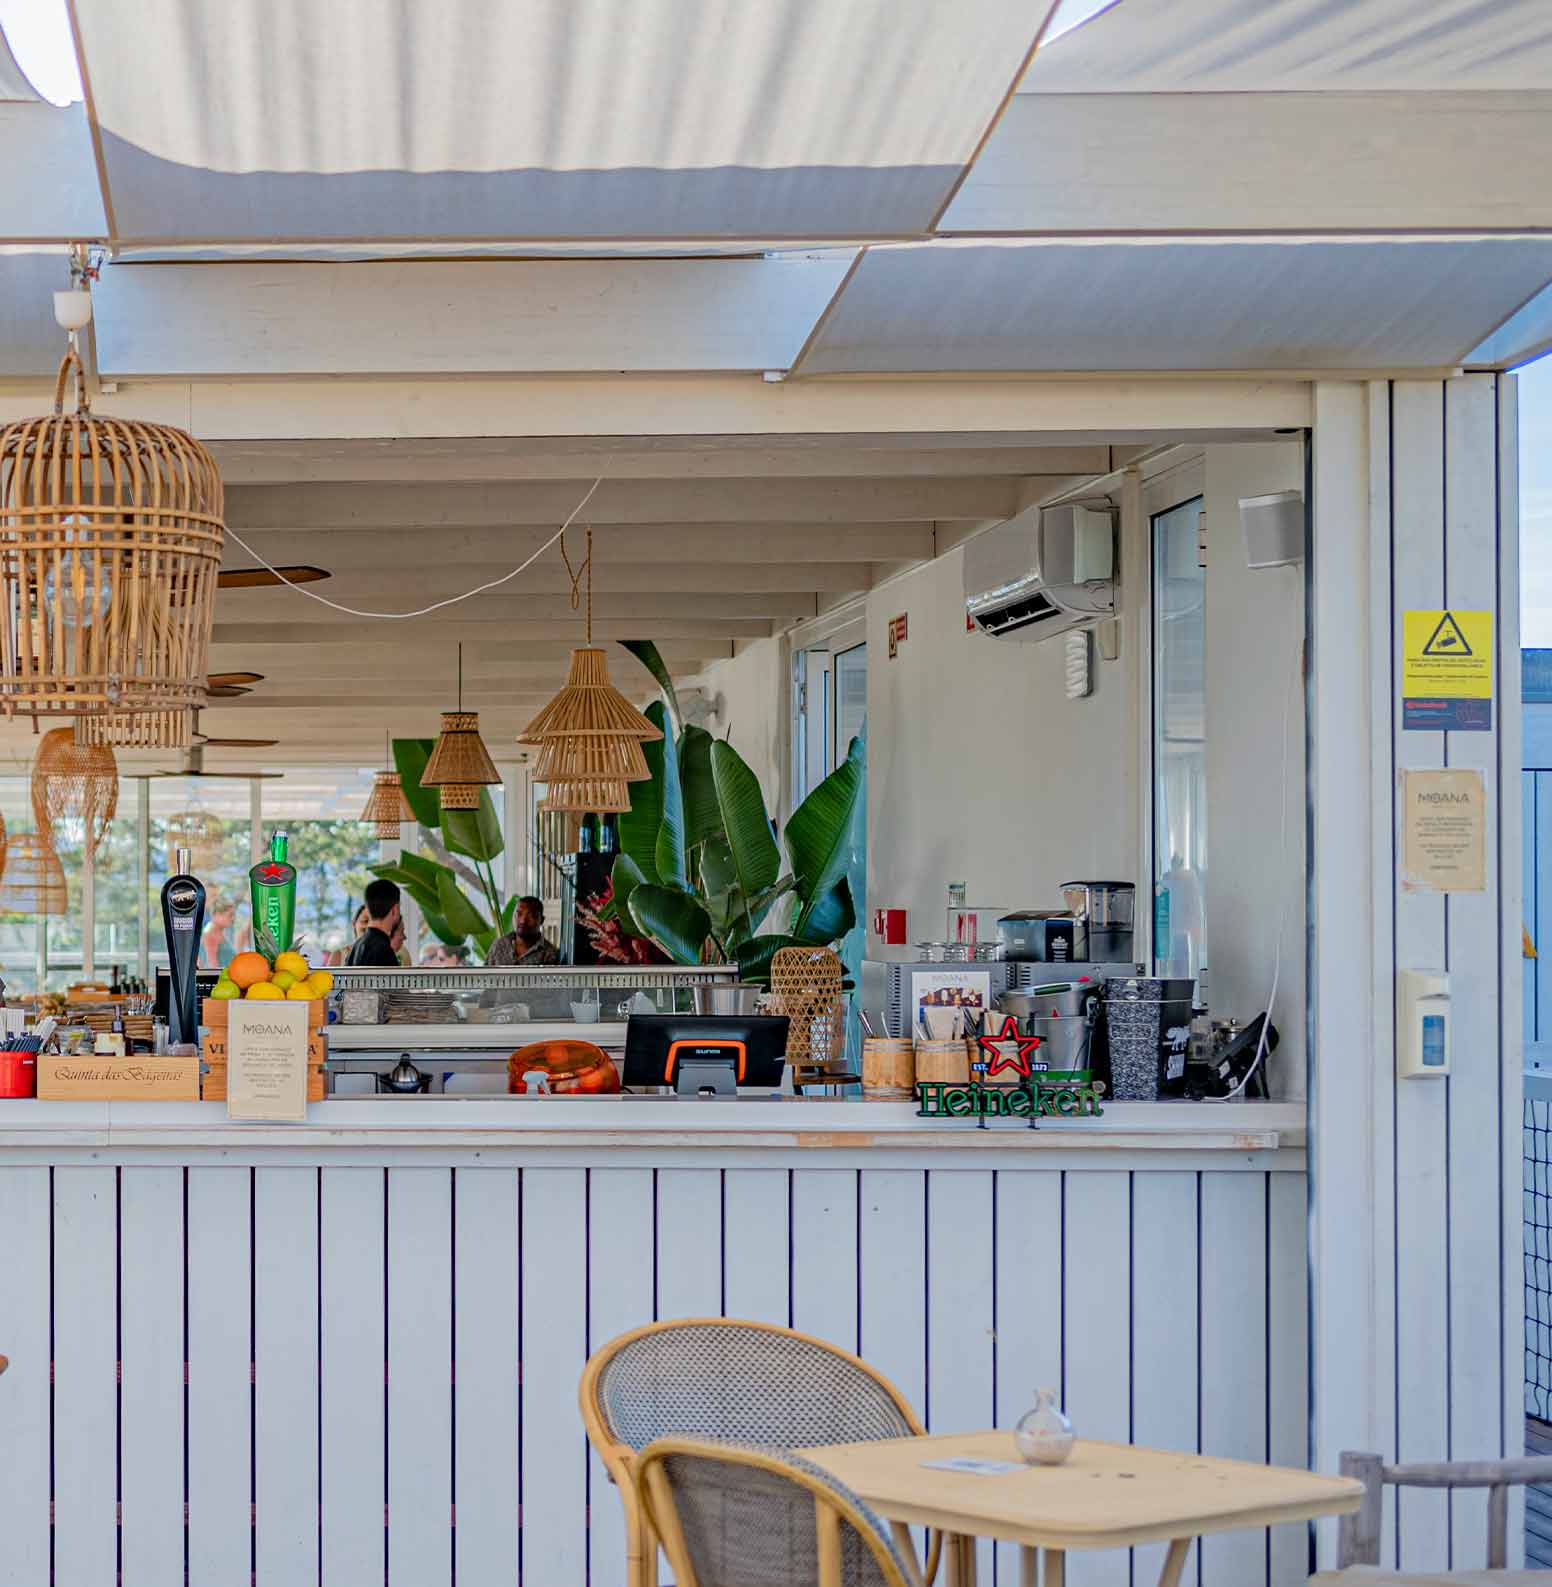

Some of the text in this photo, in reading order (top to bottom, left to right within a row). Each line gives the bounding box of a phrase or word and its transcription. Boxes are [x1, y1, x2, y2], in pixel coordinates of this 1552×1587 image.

[1417, 793, 1470, 804] MOANA
[243, 1024, 293, 1035] MOANA
[55, 1066, 98, 1081] Quinta
[101, 1065, 120, 1081] das
[917, 1082, 1104, 1117] Heineken
